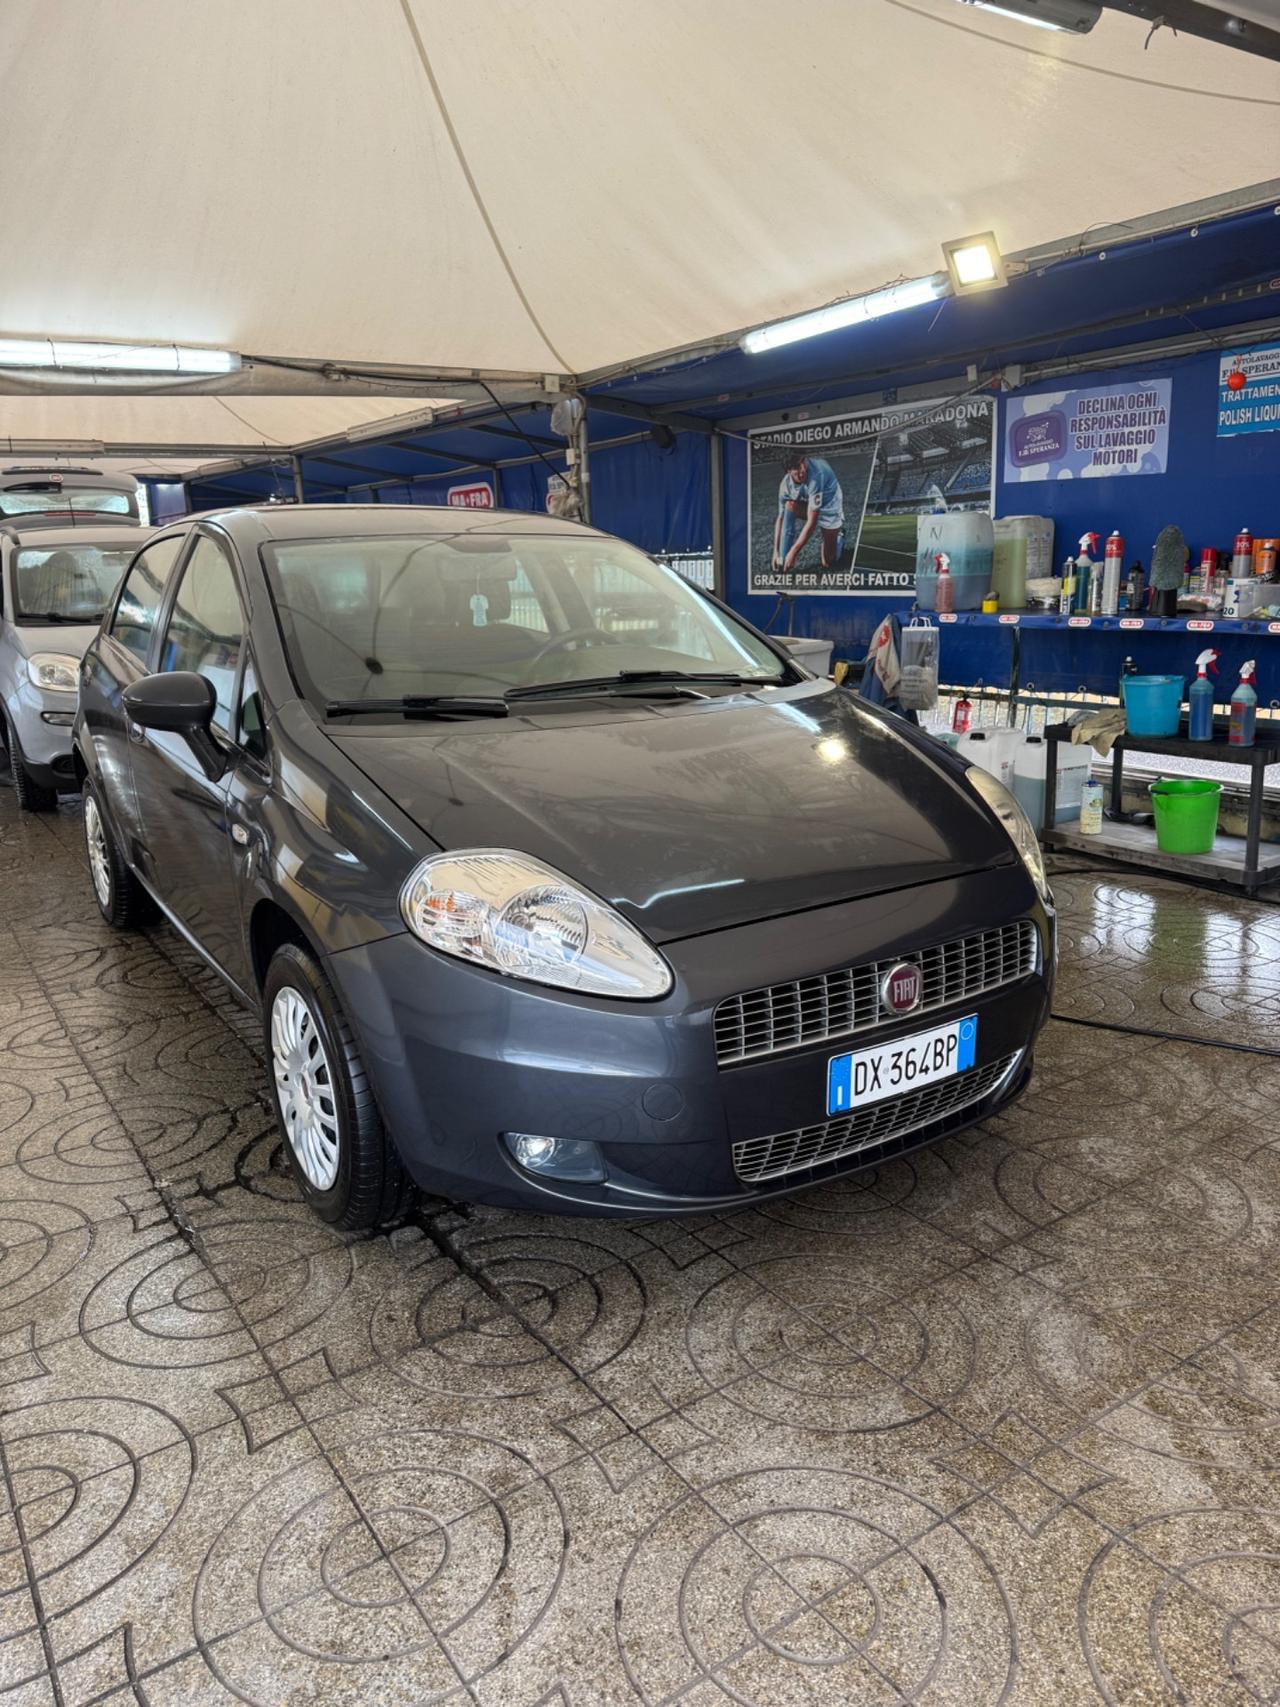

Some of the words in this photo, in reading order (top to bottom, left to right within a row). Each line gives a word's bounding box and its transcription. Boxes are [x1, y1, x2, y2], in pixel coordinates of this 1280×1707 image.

[1078, 397, 1124, 415] DECLINA
[1127, 392, 1157, 410] OGNI
[1070, 407, 1166, 432] RESPONSABILITÀ
[1219, 408, 1252, 426] POLISH
[753, 432, 793, 449] STADIO
[795, 426, 832, 443] DIEGO
[835, 414, 900, 438] ARMANDO
[1076, 435, 1097, 450] SUL
[1099, 429, 1156, 447] LAVAGGIO
[1093, 449, 1138, 466] MOTORI
[754, 573, 793, 586] GRAZIE
[795, 573, 817, 586] PER
[821, 573, 864, 586] AVERCI
[868, 573, 910, 586] FATTO
[893, 976, 916, 1003] FIAT
[854, 1055, 883, 1096] DX
[890, 1034, 958, 1085] 364BP
